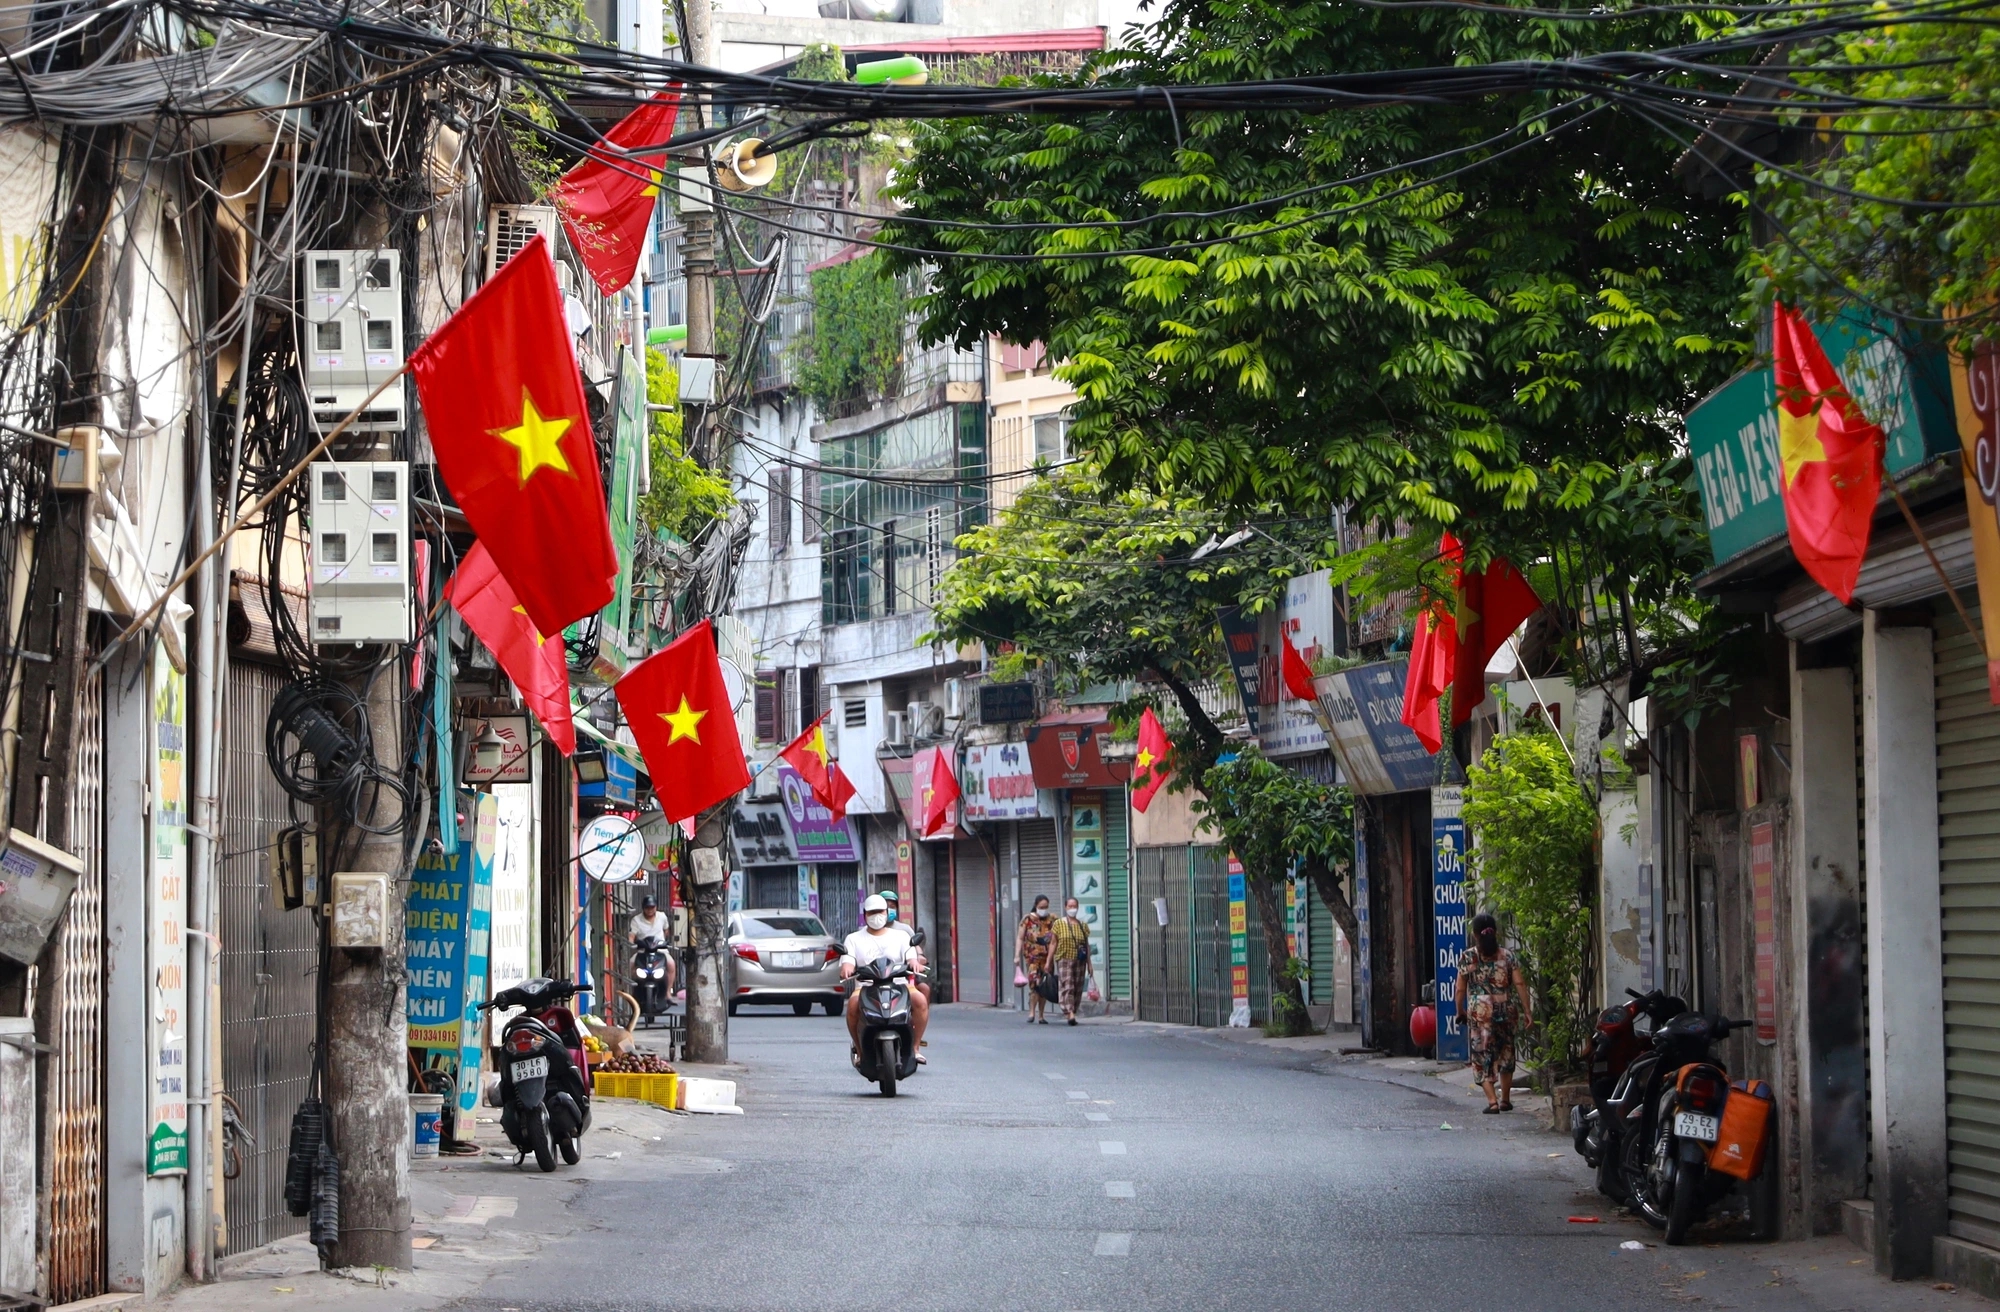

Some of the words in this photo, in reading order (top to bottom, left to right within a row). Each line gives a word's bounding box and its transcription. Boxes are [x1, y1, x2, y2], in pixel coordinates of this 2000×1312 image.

[1697, 452, 1724, 530] XE
[1714, 439, 1744, 521] GA
[1738, 421, 1769, 506] XE
[1367, 696, 1392, 726] ĐỨC
[406, 879, 463, 901] PHÁT
[406, 908, 459, 933] ĐIỆN
[1436, 915, 1465, 935] THAY
[408, 937, 455, 959] MÁY
[408, 966, 452, 988] NÉN
[1440, 976, 1456, 1002] RỬ
[409, 996, 446, 1017] KHÍ
[409, 1029, 457, 1042] 0913341915
[516, 1058, 541, 1071] 30-L6
[517, 1067, 542, 1080] 9580
[1682, 1113, 1712, 1128] 29-E2
[1679, 1124, 1715, 1139] 123.15
